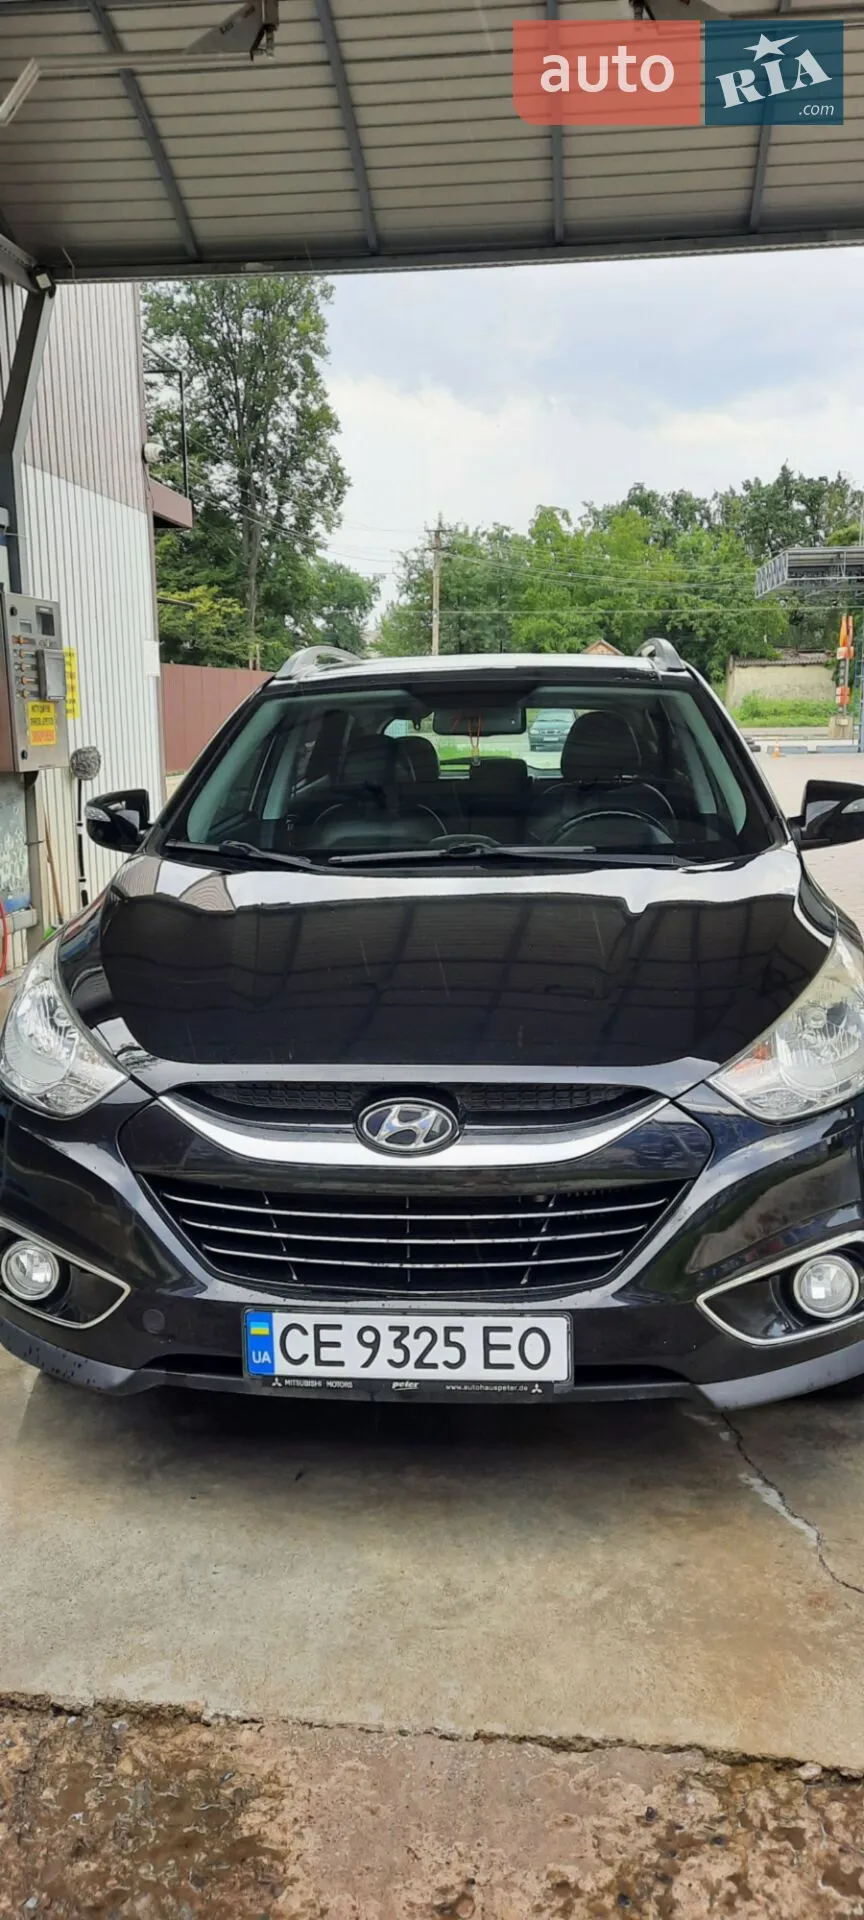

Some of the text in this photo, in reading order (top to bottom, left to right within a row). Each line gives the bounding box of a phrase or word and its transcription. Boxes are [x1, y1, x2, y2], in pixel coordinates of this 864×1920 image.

[279, 1322, 552, 1371] CE 9325 EO
[251, 1351, 272, 1364] UA
[284, 1379, 354, 1389] MITSUBISHI MOTORS
[391, 1380, 419, 1390] peter
[445, 1384, 528, 1393] www.autohauspeter.de
